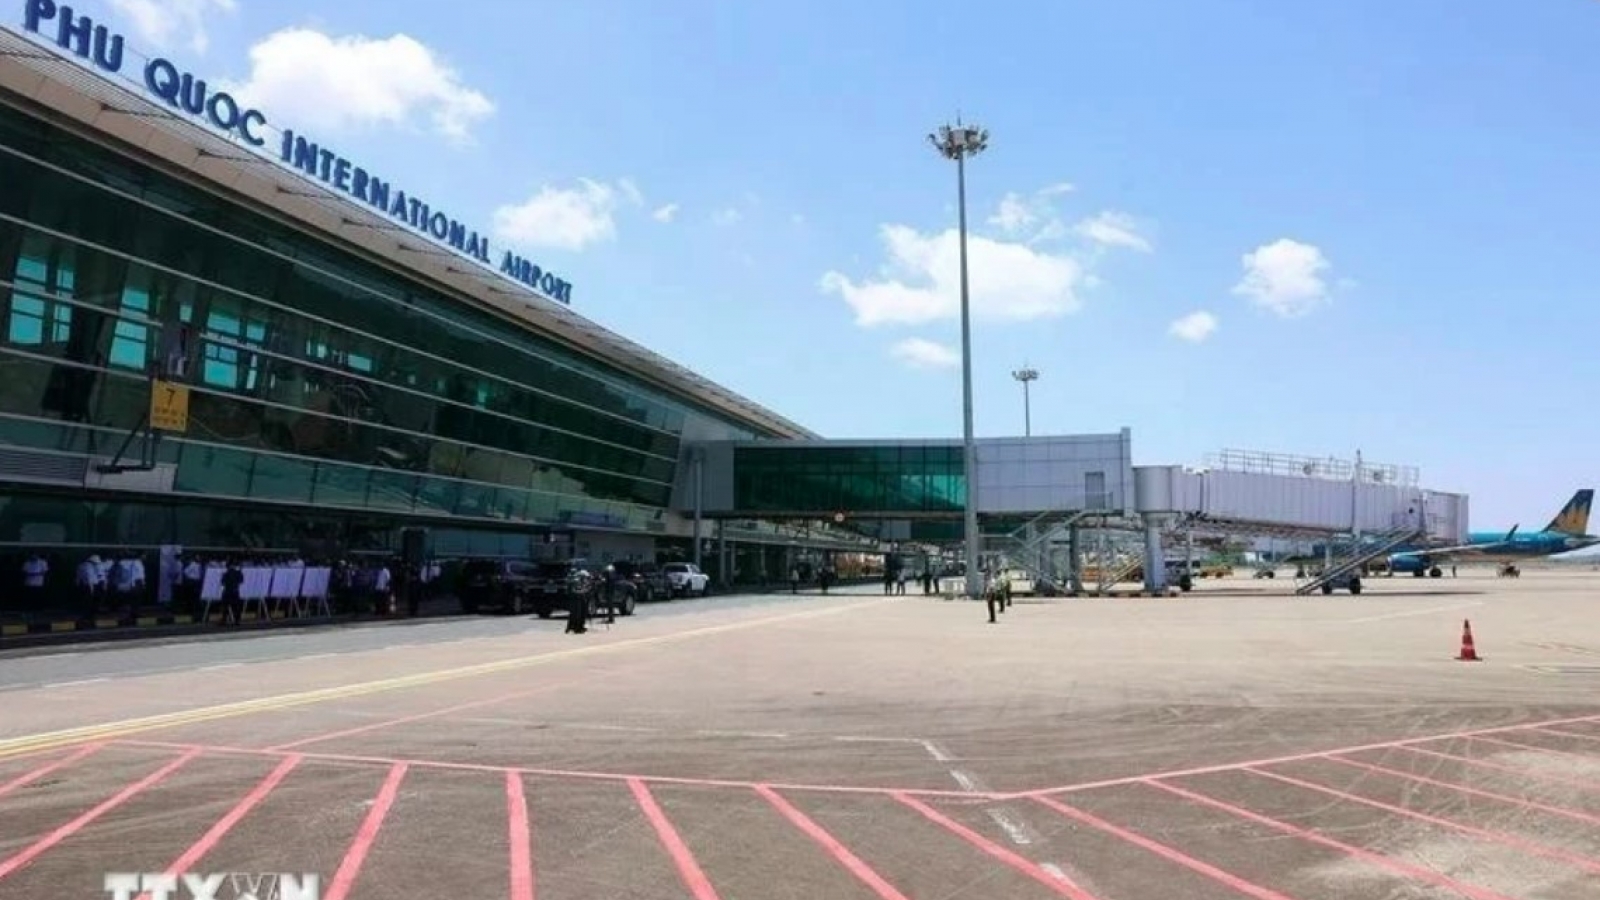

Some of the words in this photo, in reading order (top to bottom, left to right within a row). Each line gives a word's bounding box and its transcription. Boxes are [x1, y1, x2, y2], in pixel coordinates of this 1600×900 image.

[25, 0, 124, 72] PHU
[144, 58, 266, 146] QUOC
[281, 129, 491, 263] INTERNATIONAL
[501, 250, 573, 304] AIRPORT
[166, 388, 175, 406] 7
